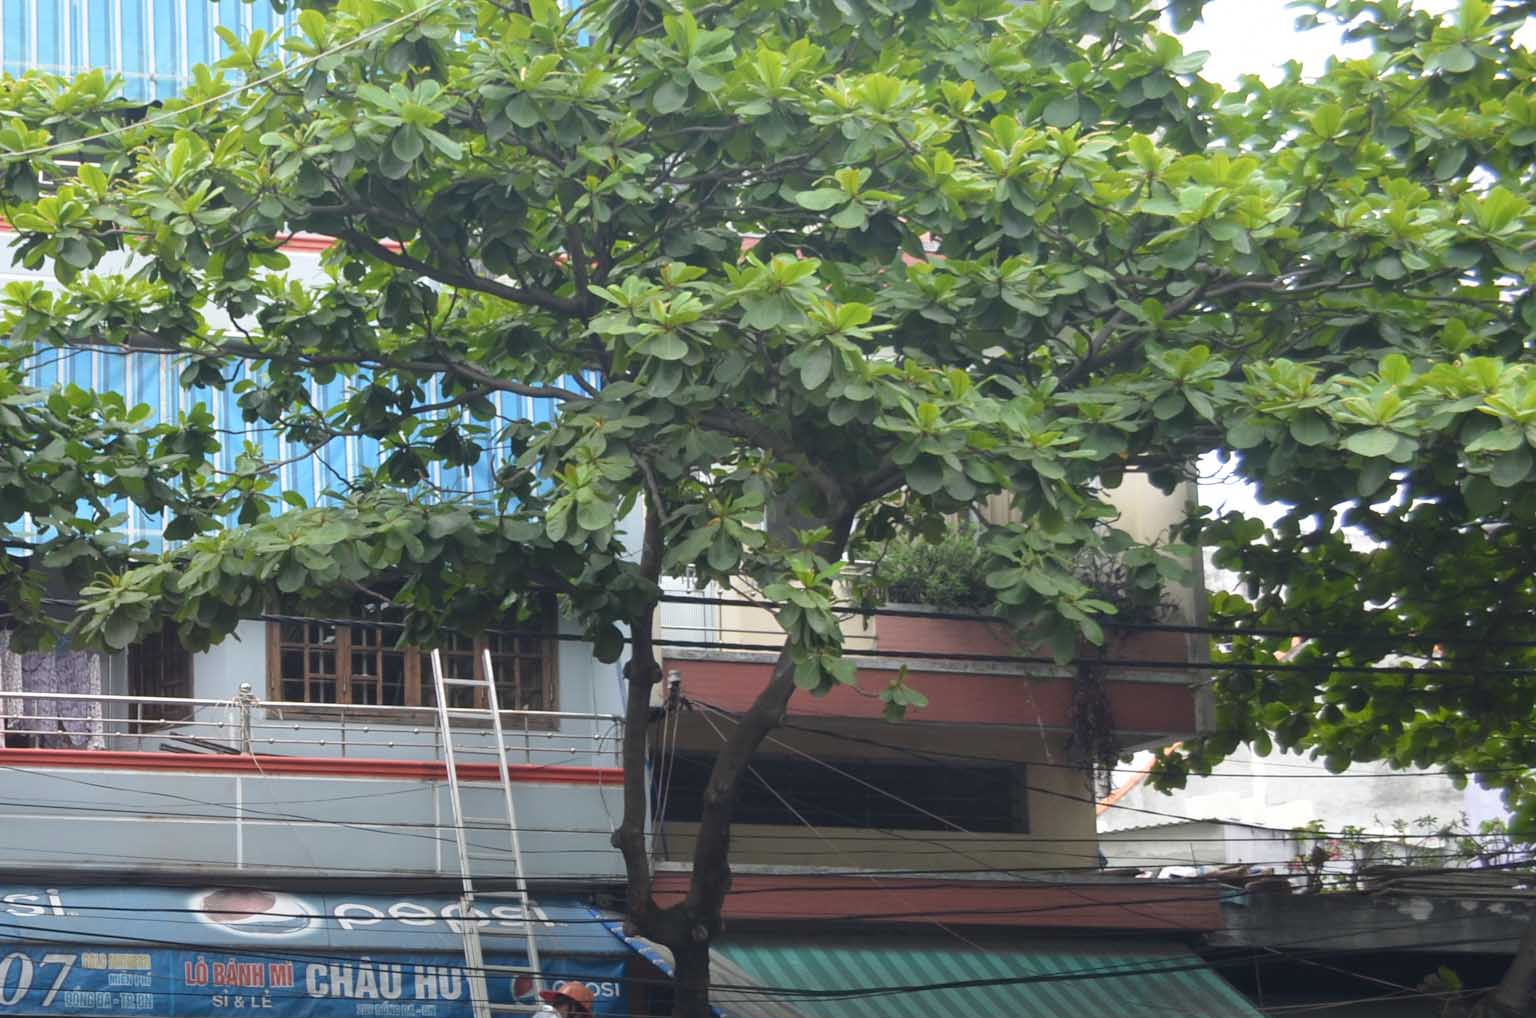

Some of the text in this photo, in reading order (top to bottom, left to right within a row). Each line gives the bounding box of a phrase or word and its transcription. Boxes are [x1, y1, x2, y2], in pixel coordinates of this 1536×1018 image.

[306, 954, 472, 1001] CHÂU HU
[234, 996, 245, 1009] &
